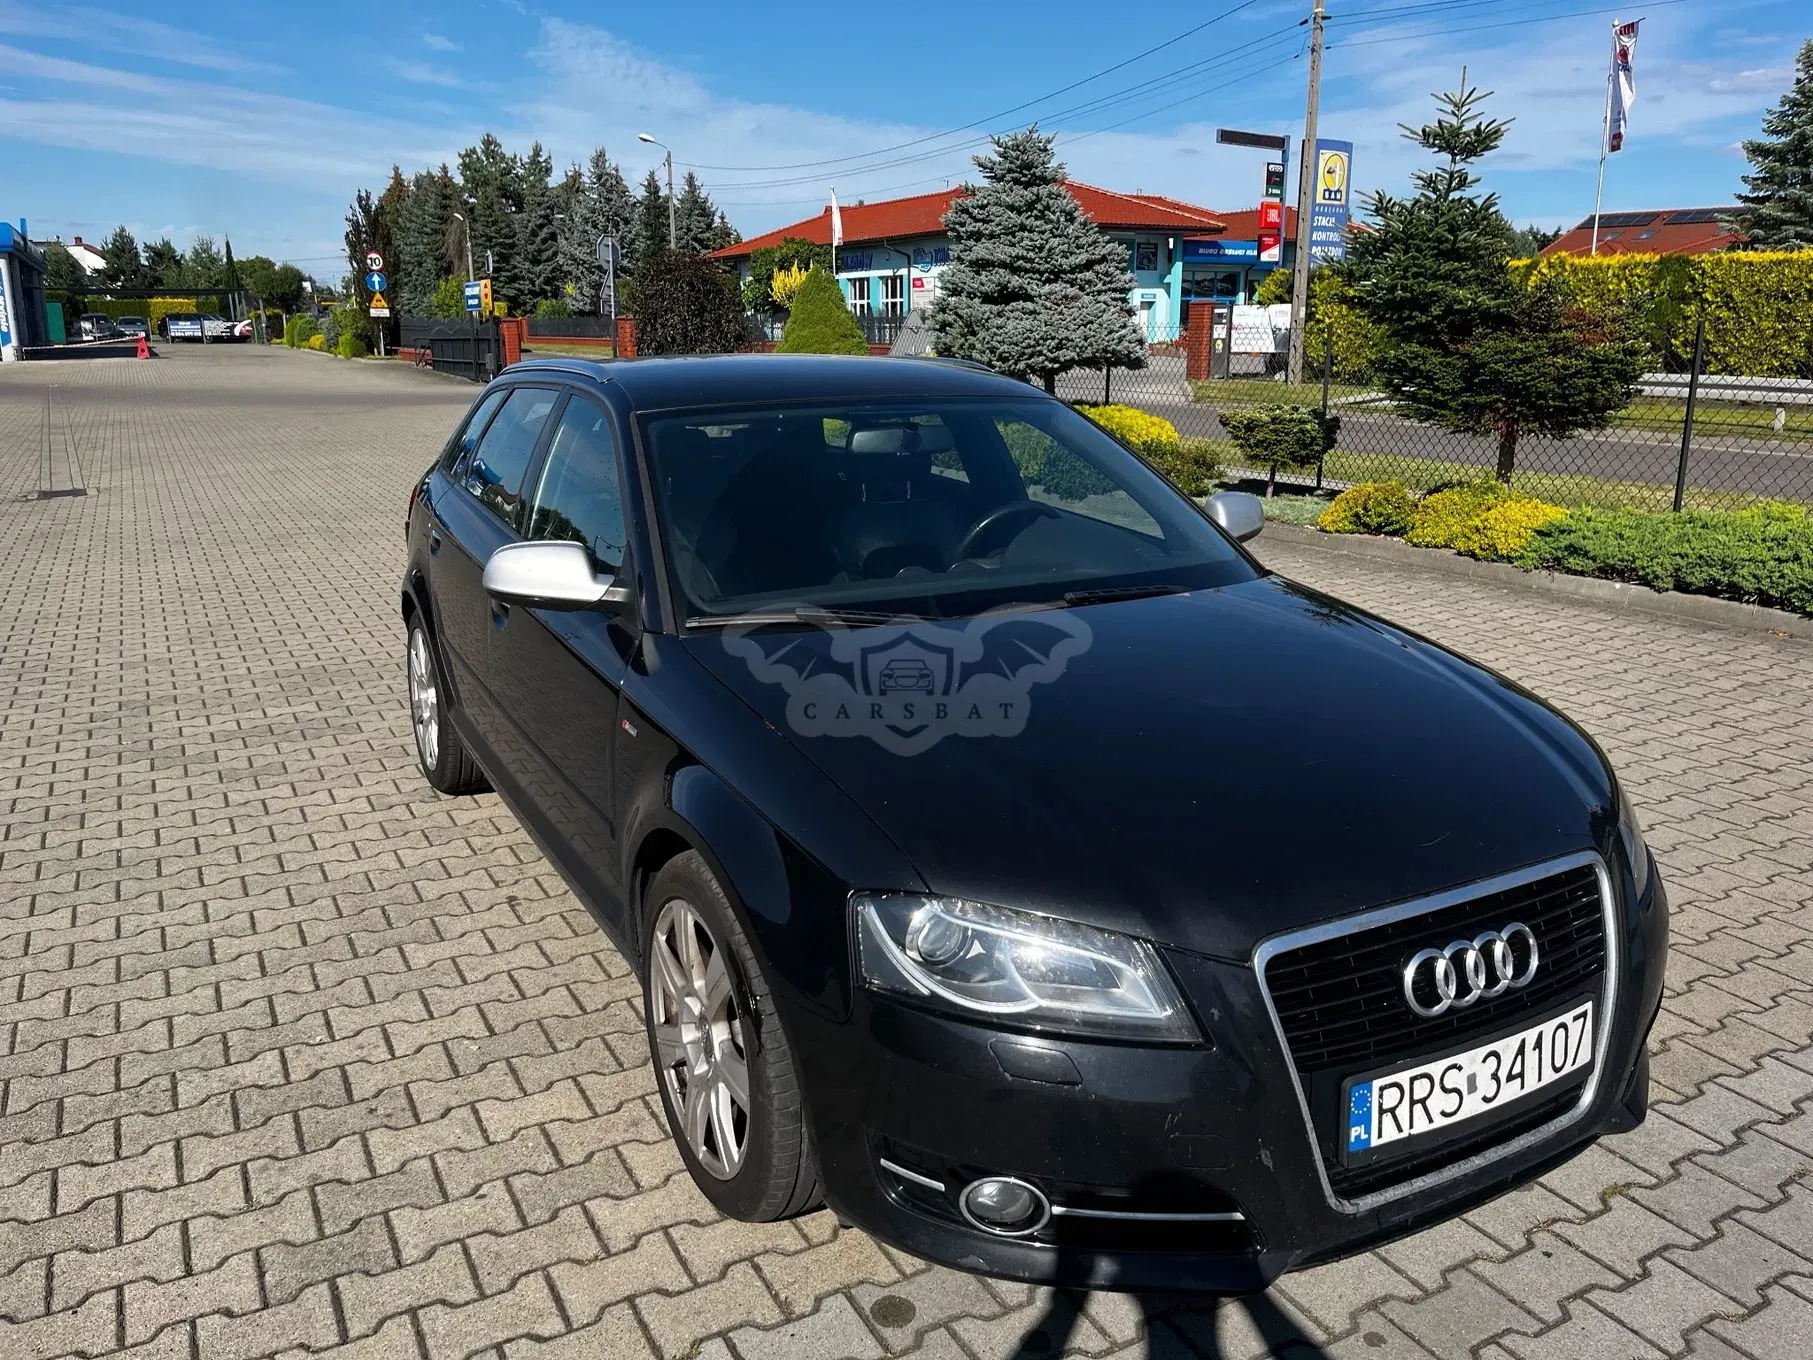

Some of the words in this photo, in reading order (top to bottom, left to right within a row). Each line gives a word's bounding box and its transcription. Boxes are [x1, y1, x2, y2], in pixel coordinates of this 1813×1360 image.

[1267, 209, 1280, 222] JBL
[368, 257, 380, 267] 10
[1377, 1062, 1464, 1139] RRS
[1481, 1009, 1588, 1104] 34107
[1351, 1125, 1369, 1142] PL
